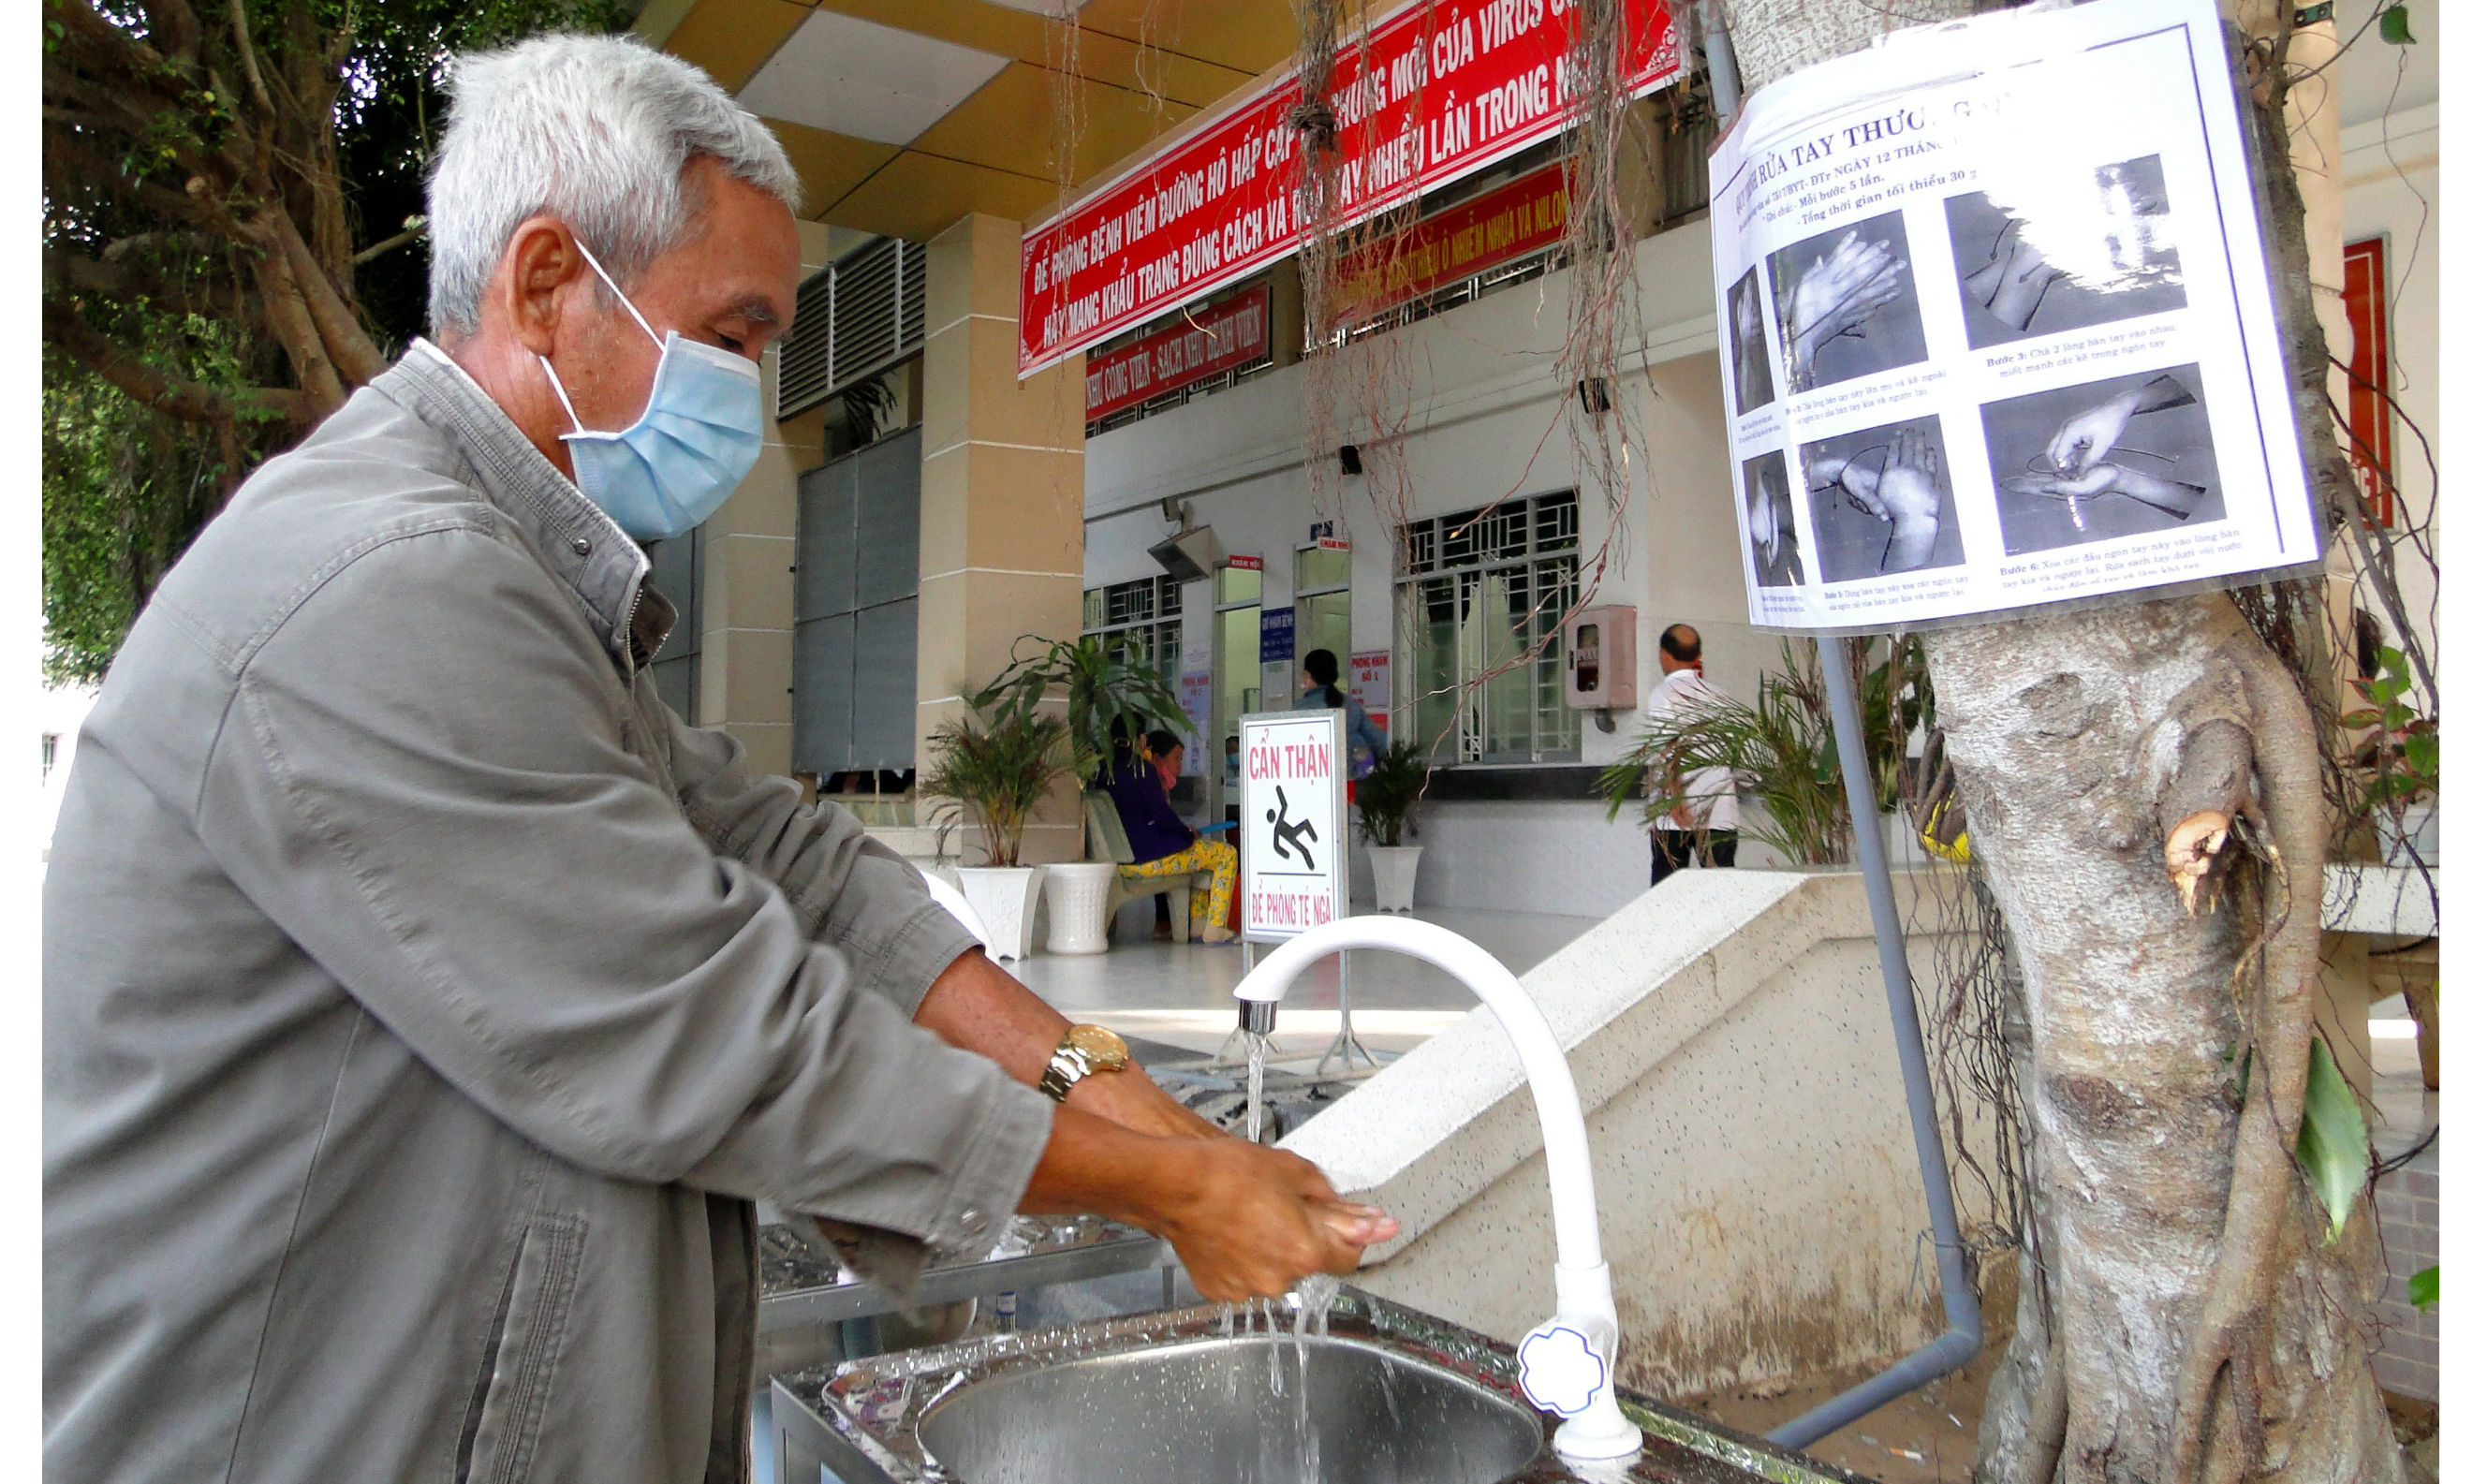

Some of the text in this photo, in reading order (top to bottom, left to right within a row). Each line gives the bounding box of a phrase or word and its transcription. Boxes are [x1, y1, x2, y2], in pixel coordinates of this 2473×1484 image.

[1052, 235, 1088, 287] PHÒNG
[1091, 216, 1123, 268] BỆNH
[1126, 194, 1156, 245] VIÊM
[1158, 169, 1203, 228] ĐƯỜNG
[1207, 147, 1227, 202] HÔ
[1231, 125, 1262, 190] HẤP
[1331, 64, 1387, 132] HỦNG
[1433, 7, 1475, 80] CỦA
[1479, 0, 1544, 54] VIRUS
[1759, 151, 1789, 184] RỬA
[1791, 134, 1835, 167] TAY
[1834, 155, 1871, 178] NGÀY
[1877, 153, 1892, 165] 12
[1068, 290, 1099, 338] MANG
[1102, 257, 1135, 321] KHẨU
[1138, 250, 1180, 304] TRANG
[1183, 228, 1220, 284] ĐÚNG
[1223, 208, 1262, 263] CÁCH
[1266, 184, 1288, 242] VÀ
[1368, 112, 1425, 194] NHIỀU
[1431, 89, 1471, 165] LẦN
[1476, 64, 1549, 142] TRONG
[1799, 193, 1818, 209] Mỗi
[1819, 184, 1847, 201] bước
[1849, 181, 1857, 192] 5
[1829, 198, 1852, 216] thời
[1855, 192, 1883, 210] gian
[1887, 182, 1906, 198] tối
[1909, 173, 1947, 193] thiểu
[1950, 169, 1965, 183] 30
[1487, 207, 1515, 255] NHỰA
[1518, 193, 1531, 241] VÀ
[1106, 357, 1128, 403] CÔNG
[1129, 345, 1151, 391] VIÊN
[1157, 337, 1184, 387] SẠCH
[1236, 298, 1261, 355] VIỆN
[1986, 357, 2014, 367] Bước
[2018, 352, 2027, 360] 3:
[2030, 348, 2050, 359] Chà
[2053, 345, 2060, 354] 2
[2063, 342, 2084, 352] lòng
[2087, 338, 2106, 346] bàn
[2110, 334, 2126, 343] tay
[2128, 330, 2146, 339] vào
[1999, 366, 2022, 378] miết
[2025, 360, 2053, 373] mạnh
[2057, 357, 2072, 366] các
[2092, 348, 2118, 360] trong
[2122, 343, 2146, 354] ngón
[1999, 566, 2026, 576] Bước
[2030, 563, 2039, 571] 6:
[2042, 560, 2061, 569] Xoa
[2064, 555, 2080, 566] các
[2083, 551, 2101, 562] đầu
[2104, 547, 2128, 560] ngón
[2131, 544, 2148, 554] tay
[2152, 540, 2171, 551] này
[2173, 536, 2192, 547] vào
[2195, 533, 2218, 544] lòng
[2002, 580, 2018, 589] tay
[2022, 576, 2036, 586] kia
[2039, 573, 2051, 582] và
[2054, 567, 2083, 581] ngược
[2105, 561, 2125, 571] Rửa
[2127, 556, 2150, 568] sạch
[2154, 553, 2171, 564] tay
[1955, 576, 1968, 584] tay
[1249, 727, 1280, 780] CẨN
[1285, 734, 1329, 786] THẬN
[1267, 885, 1296, 926] PHÒNG
[1299, 885, 1309, 927] TÉ
[1313, 888, 1331, 927] NGÃ
